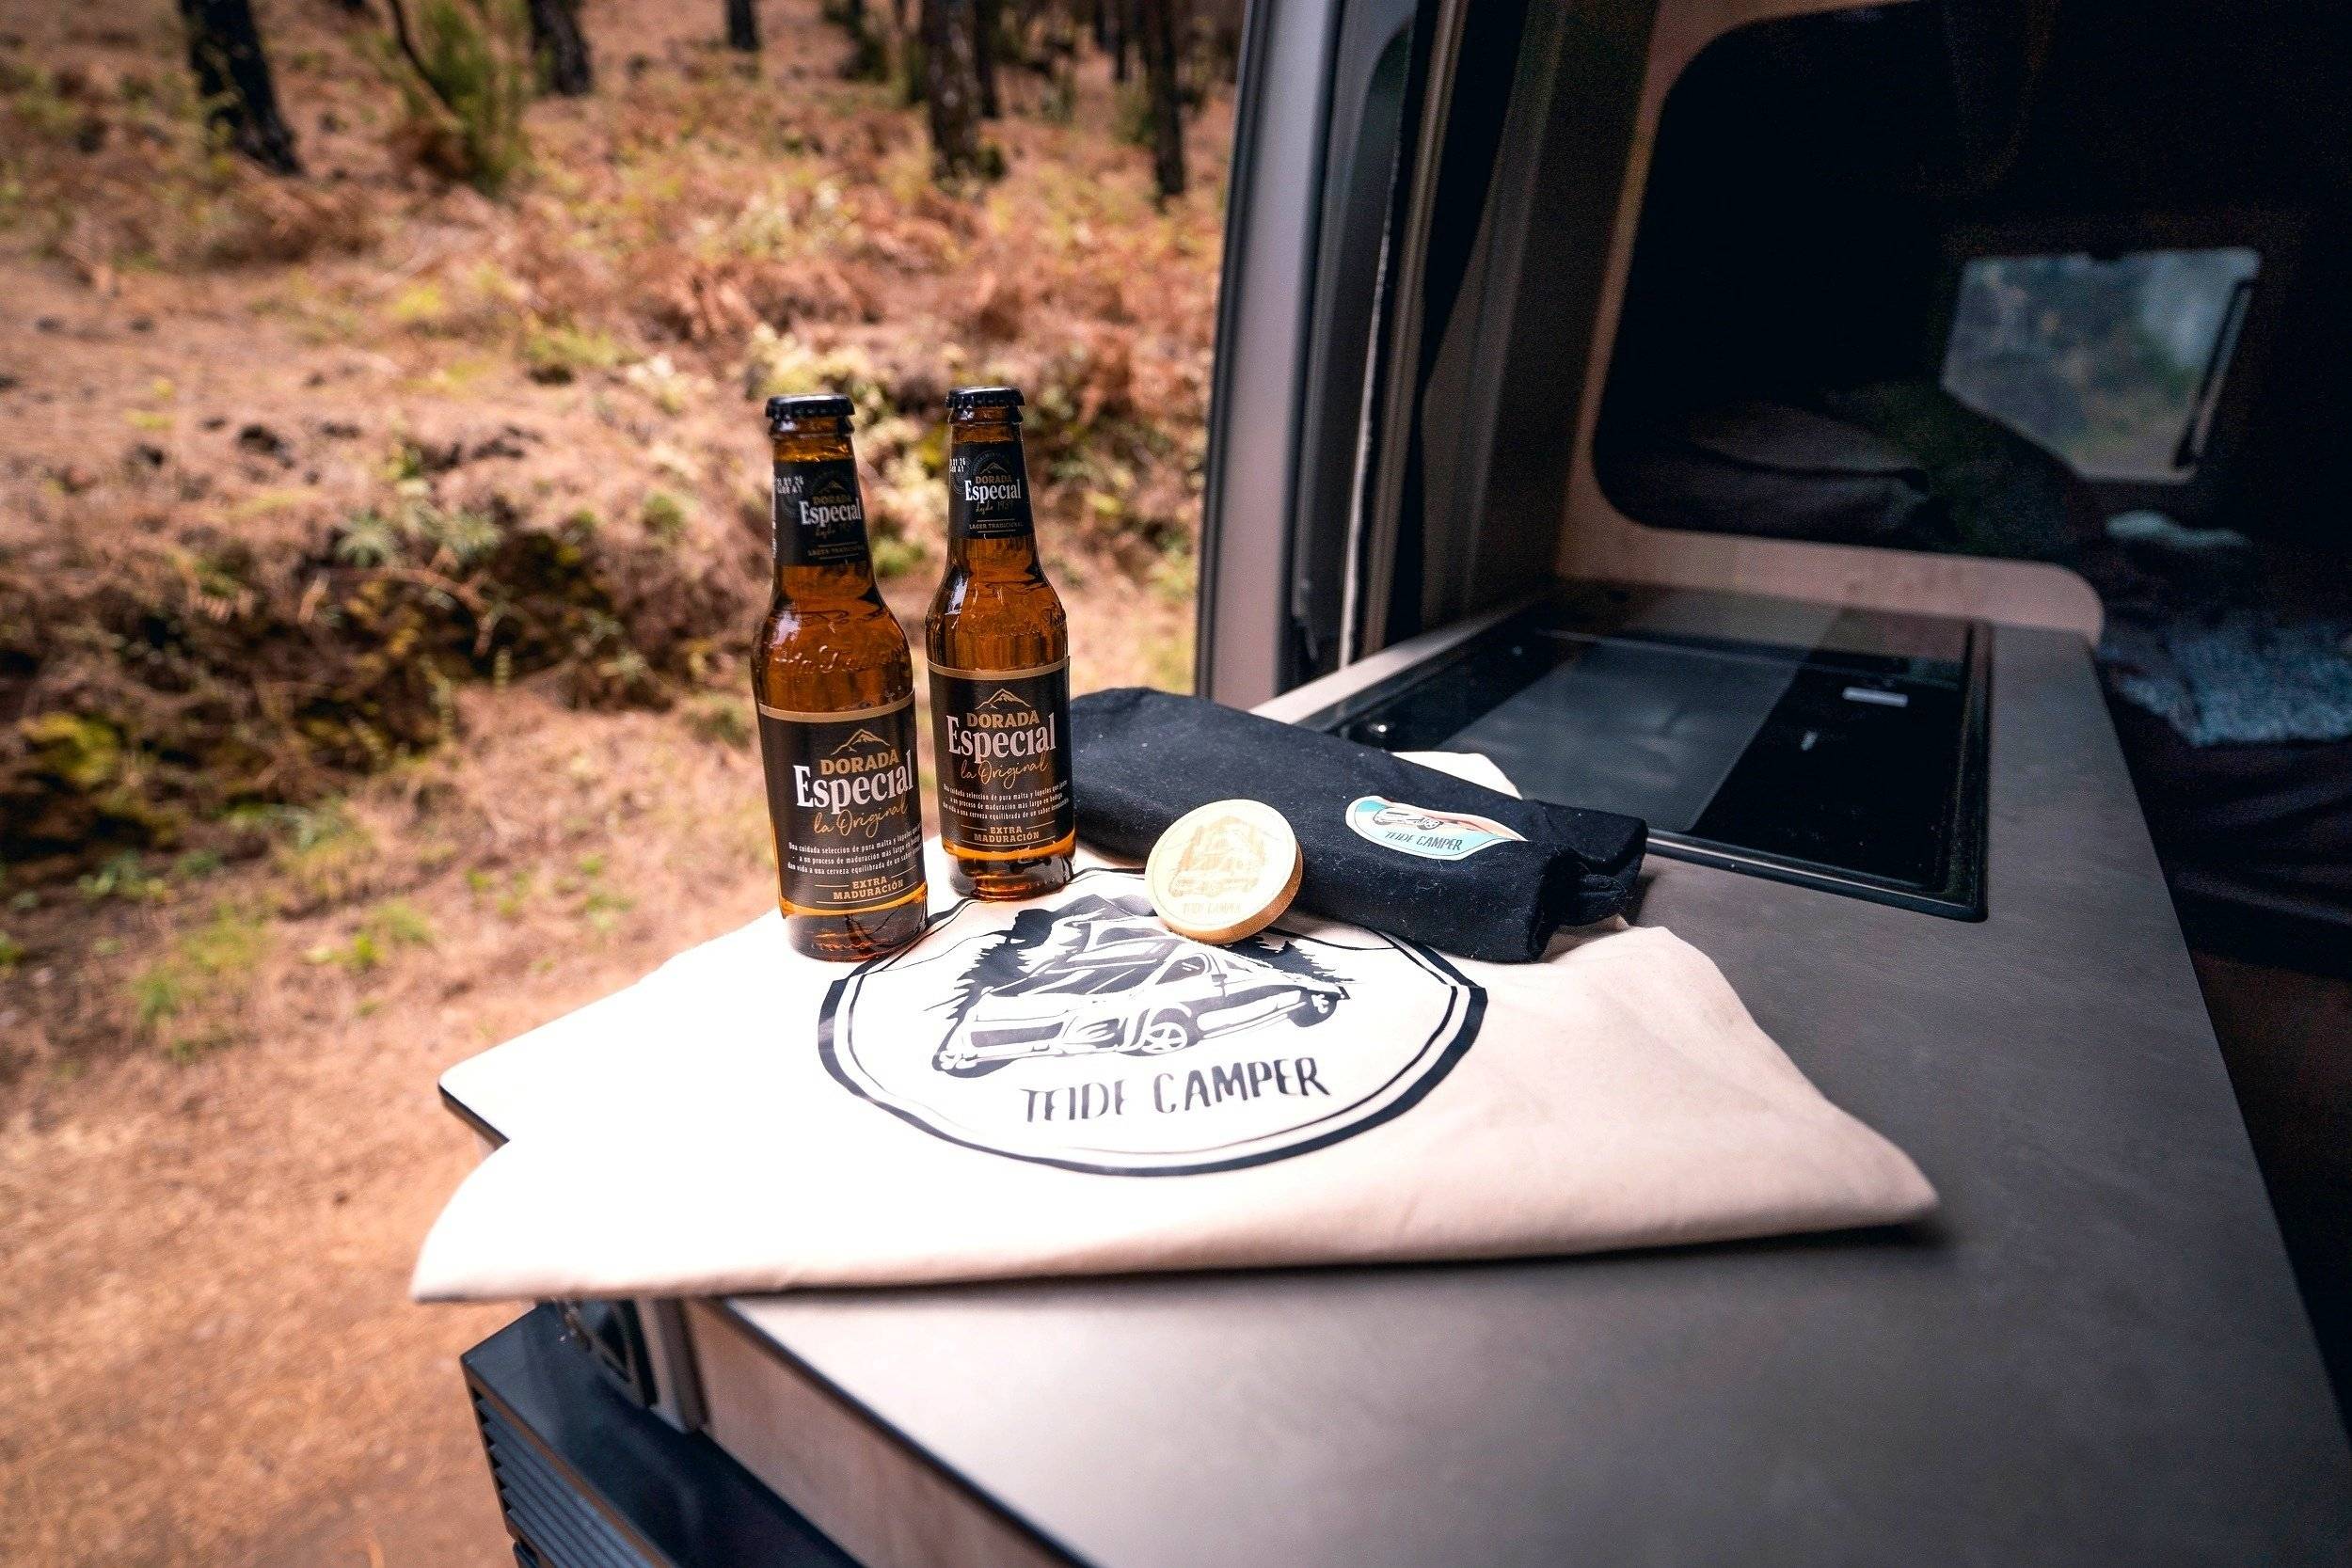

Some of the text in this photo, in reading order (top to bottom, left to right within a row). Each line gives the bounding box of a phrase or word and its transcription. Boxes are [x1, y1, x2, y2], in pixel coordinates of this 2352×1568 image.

[976, 474, 1012, 484] DORADA
[964, 479, 1021, 504] Especial
[799, 498, 862, 527] Especial
[966, 710, 1041, 729] DORADA
[946, 712, 1057, 764] Especial
[820, 749, 899, 775] DORADA
[961, 752, 1048, 790] la Original
[793, 749, 914, 816] Especial
[1029, 800, 1042, 808] largo
[813, 797, 909, 838] la Original
[989, 812, 1021, 821] equilibrada
[974, 832, 1040, 843] MADURACIÓN
[990, 826, 1023, 834] EXTRA
[851, 845, 860, 853] de
[861, 844, 875, 853] pura
[876, 839, 892, 848] malta
[1416, 835, 1463, 851] CAMPER
[850, 862, 885, 875] equilibrada
[886, 859, 893, 867] de
[833, 879, 904, 900] MADURACIÓN
[851, 876, 888, 890] EXTRA
[1152, 1057, 1331, 1114] CAMPER
